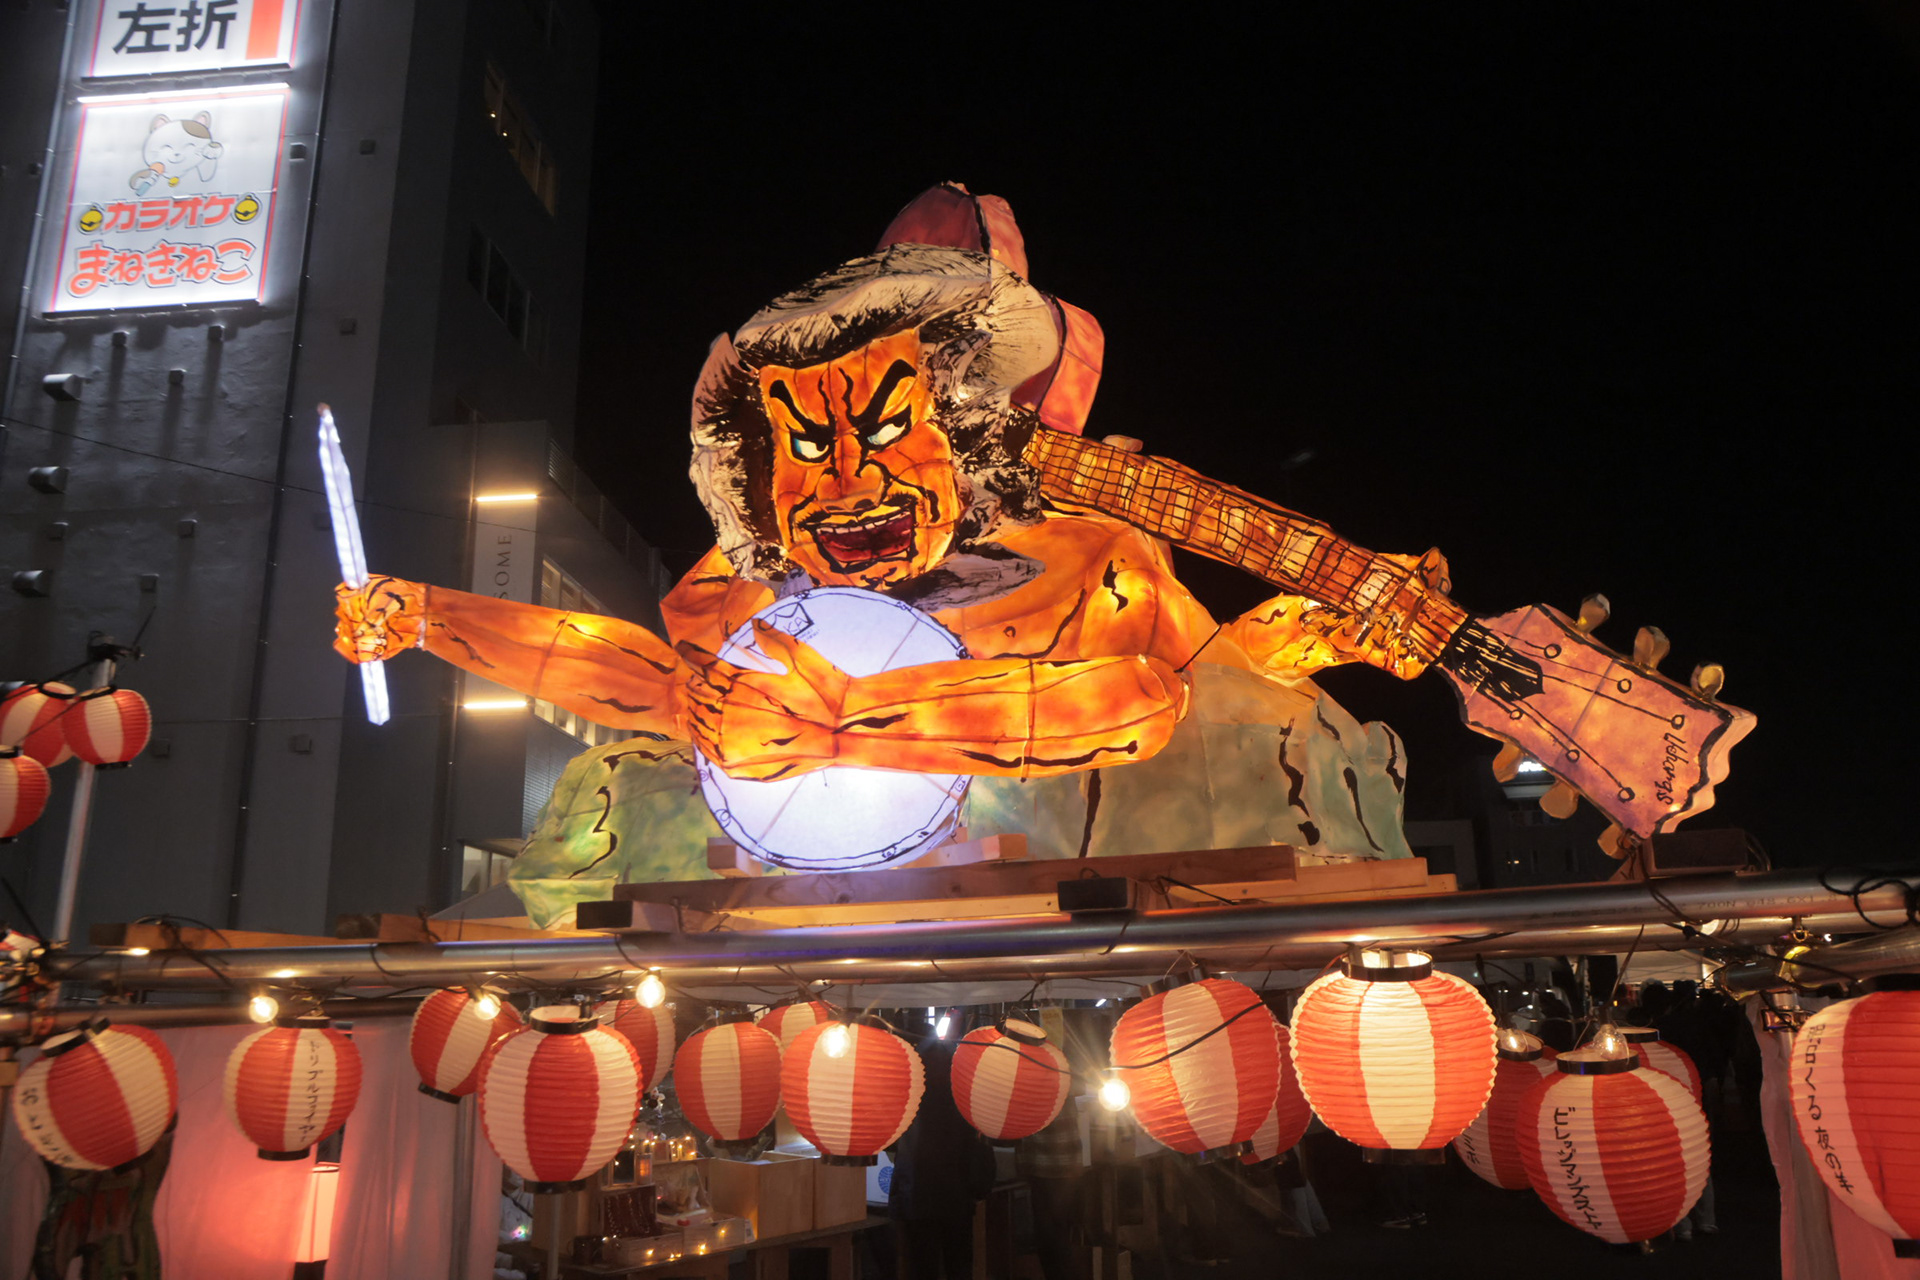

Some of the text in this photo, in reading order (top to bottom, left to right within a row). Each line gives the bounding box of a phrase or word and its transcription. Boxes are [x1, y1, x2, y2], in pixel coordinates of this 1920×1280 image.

[112, 0, 238, 54] 左折
[103, 195, 236, 231] カラオケ
[69, 240, 254, 296] まねきねこ
